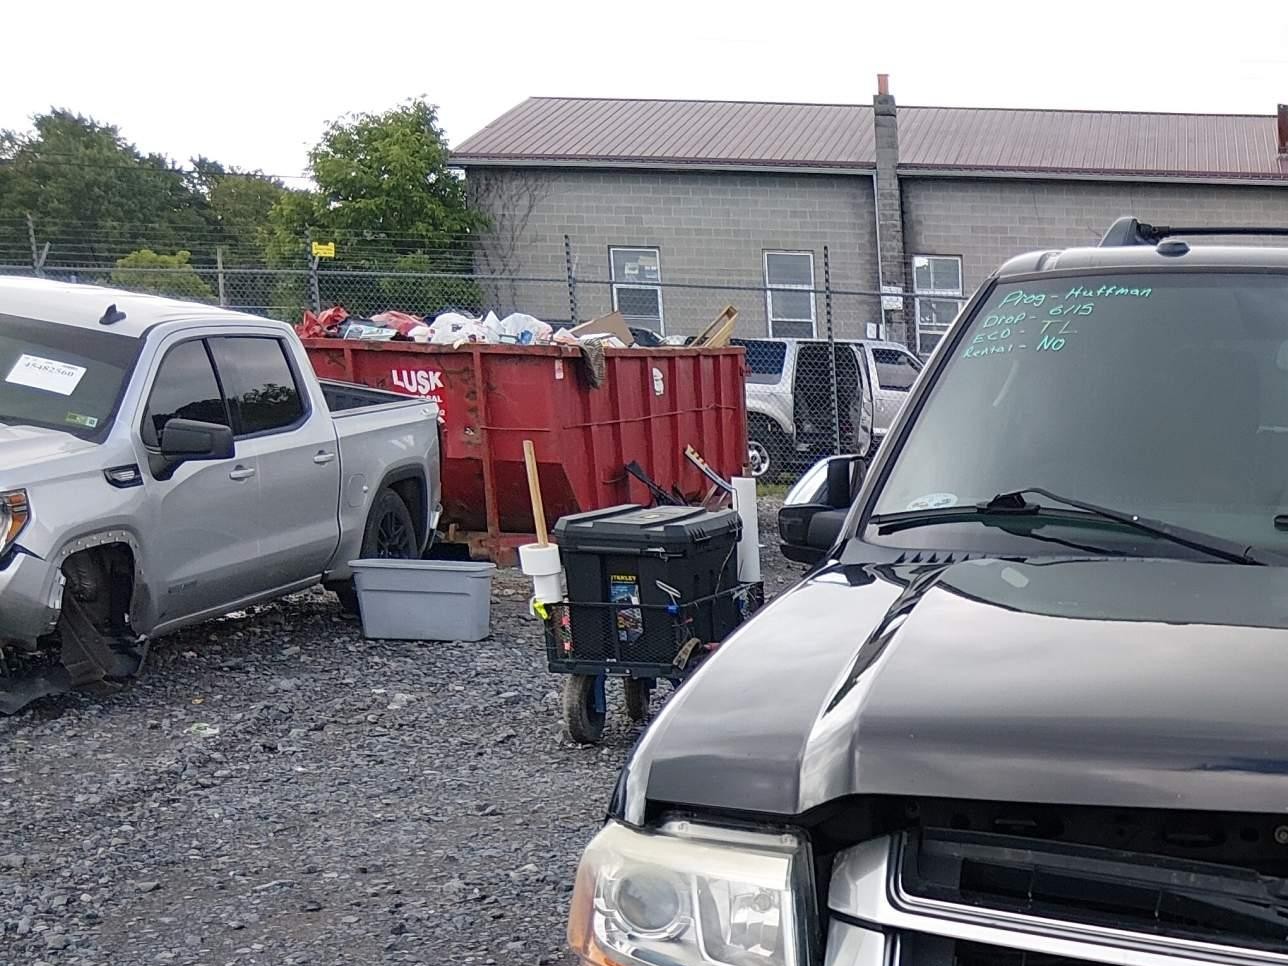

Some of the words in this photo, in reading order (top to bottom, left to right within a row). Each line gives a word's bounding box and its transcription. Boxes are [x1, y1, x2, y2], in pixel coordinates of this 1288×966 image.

[999, 291, 1046, 308] Prog
[1065, 286, 1152, 299] Huffman
[1049, 302, 1094, 316] 6/15
[963, 343, 1013, 358] Rental
[1036, 335, 1065, 351] NO
[391, 369, 444, 395] LUSK
